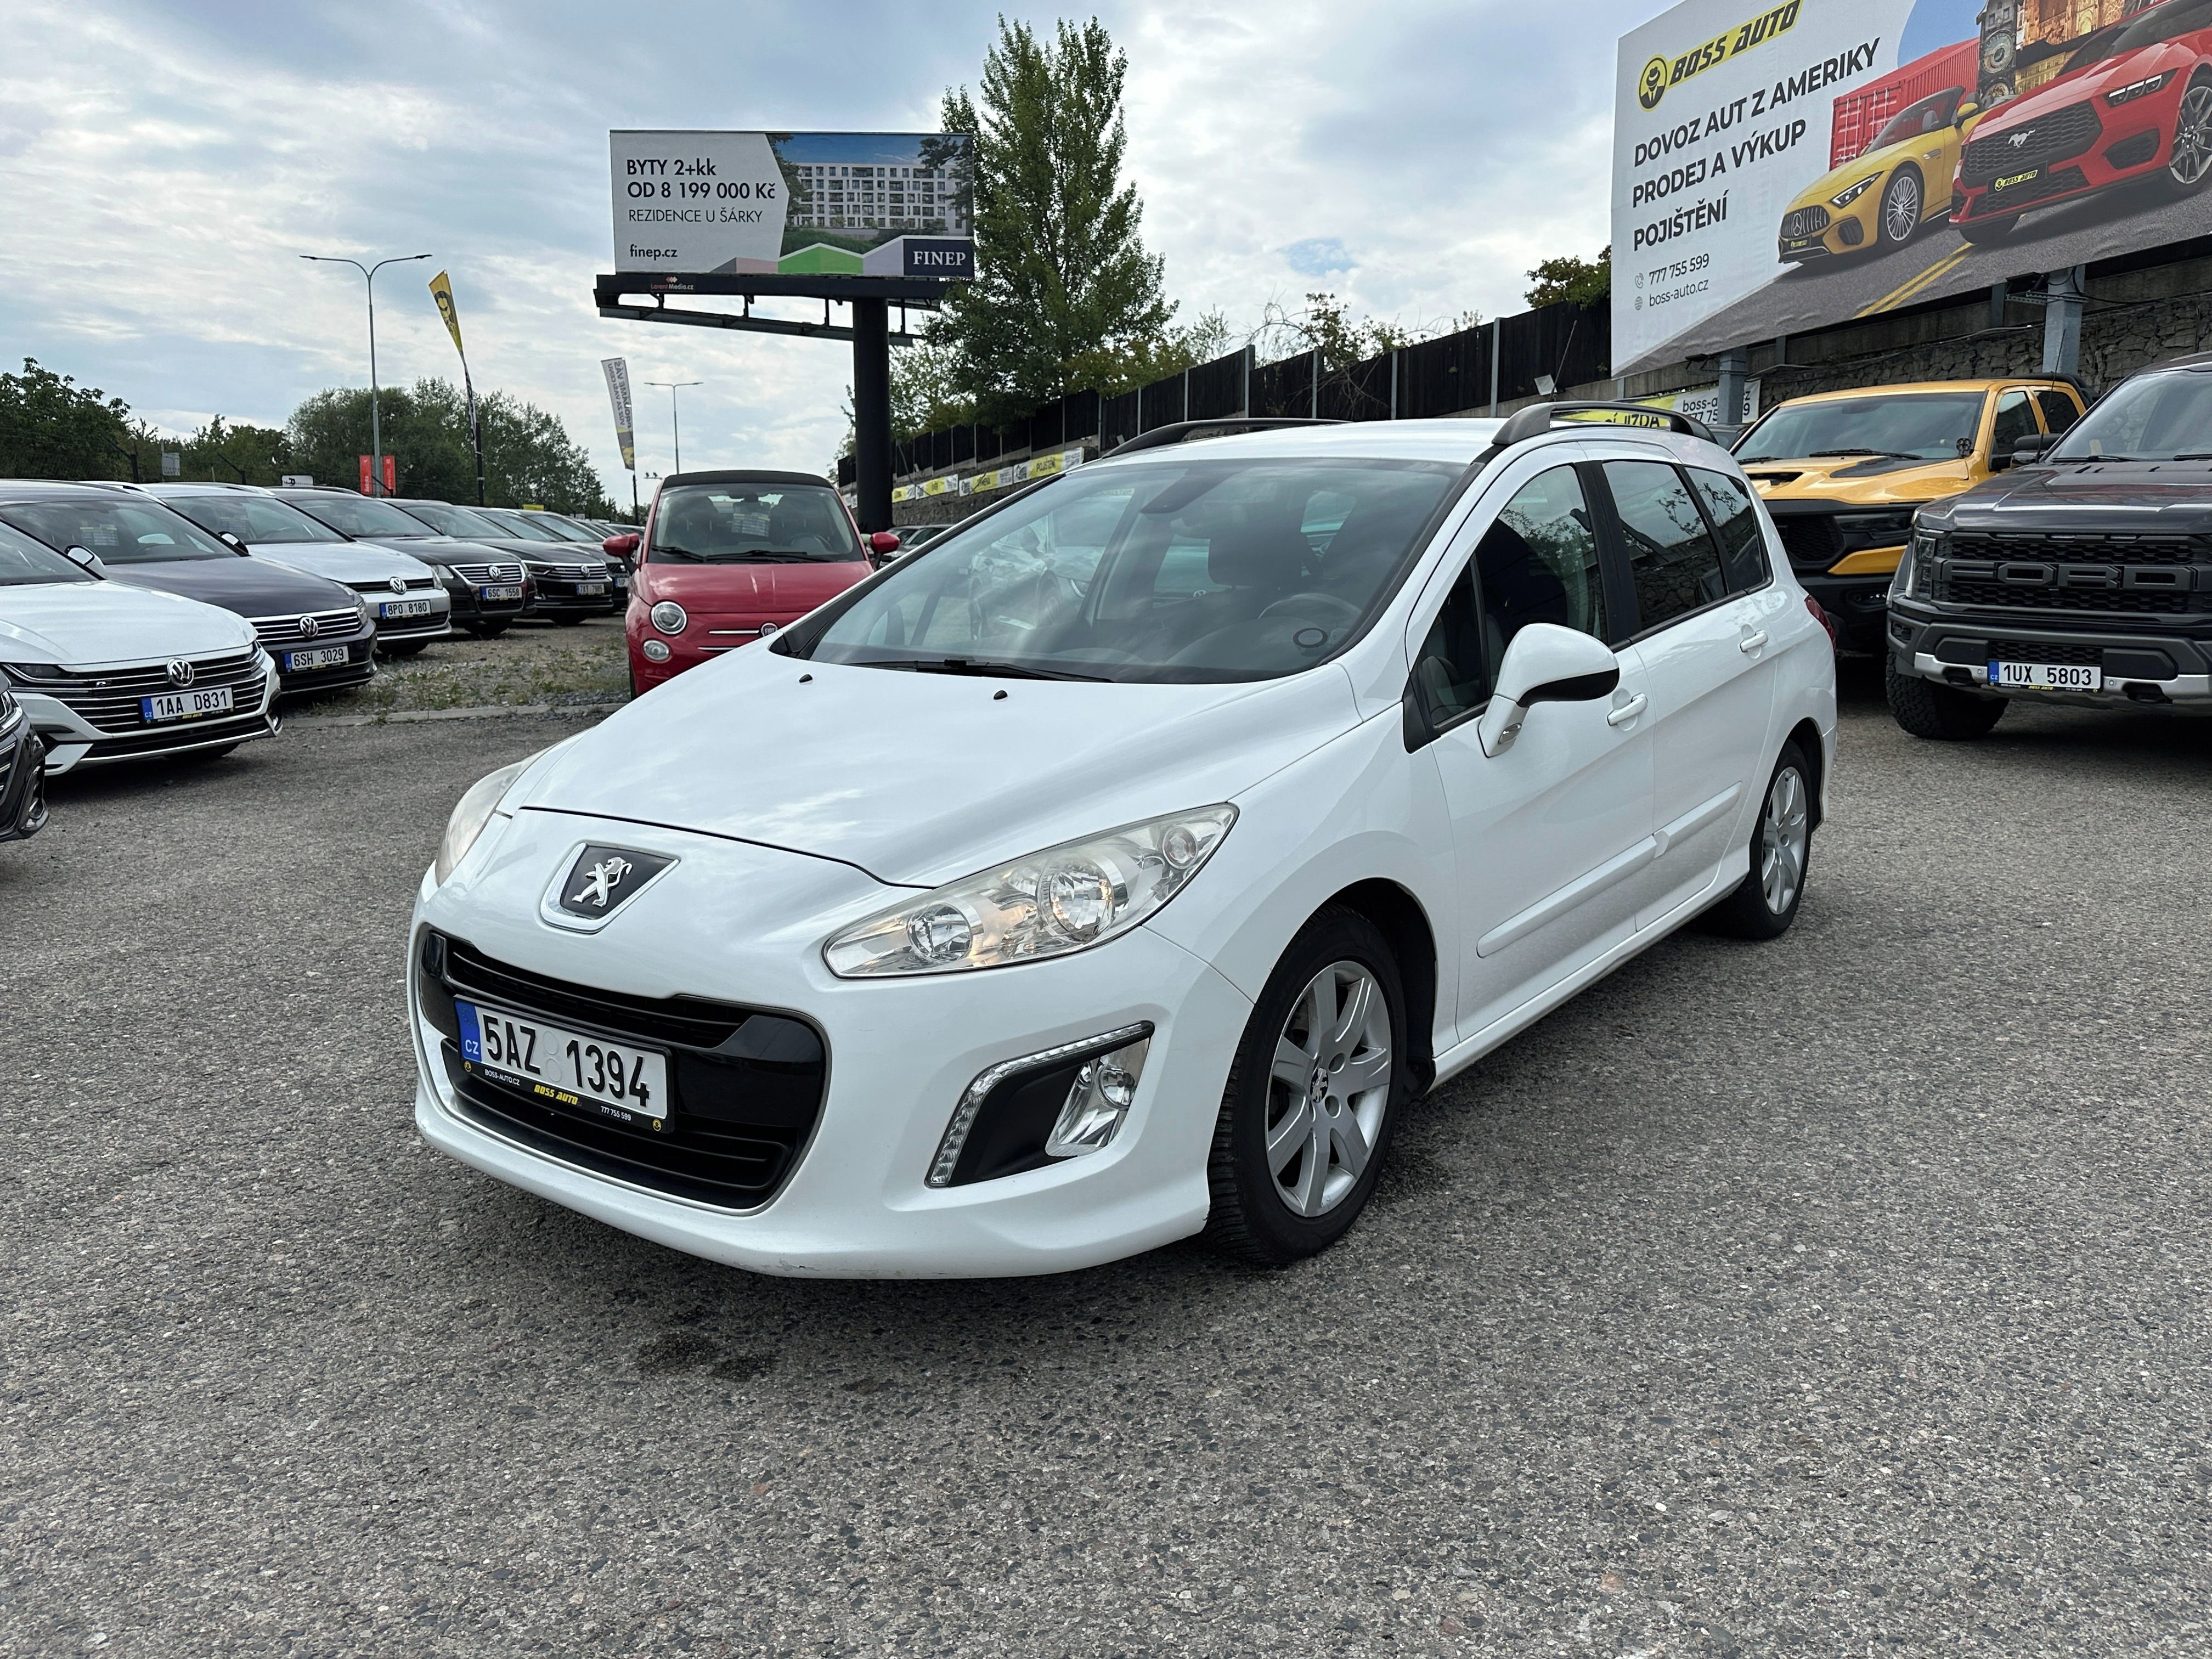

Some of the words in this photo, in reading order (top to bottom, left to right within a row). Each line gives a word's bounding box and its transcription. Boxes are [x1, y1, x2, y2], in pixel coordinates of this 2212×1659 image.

[1669, 35, 1728, 86] BOSS
[1730, 0, 1800, 55] AUTO
[1634, 117, 1701, 167] DOVOZ
[1704, 97, 1747, 138] AUT
[1751, 89, 1765, 117] Z
[1769, 37, 1880, 110] AMERIKY
[627, 159, 668, 175] BYTY
[674, 158, 716, 176] 2+kk
[1633, 158, 1706, 208] PRODEJ
[1711, 152, 1726, 178] A
[1731, 119, 1806, 168] VÝKUP
[627, 182, 655, 198] OD
[661, 182, 671, 198] 8
[680, 182, 710, 198] 199
[716, 183, 750, 199] 000
[756, 183, 775, 199] Kč
[629, 210, 701, 222] REZIDENCE
[706, 210, 715, 223] U
[720, 207, 763, 223] ŠÁRKY
[1634, 189, 1729, 251] POJIŠTĚNÍ
[630, 244, 678, 261] finep.cz
[913, 251, 966, 266] FINEP
[1649, 267, 1667, 285] 777
[1669, 260, 1687, 279] 755
[1689, 253, 1709, 272] 599
[1649, 279, 1709, 307] boss-auto.cz
[1942, 559, 2193, 591] FORD
[488, 588, 500, 597] 6SC
[409, 602, 427, 613] 8180
[294, 652, 313, 667] 6SH
[320, 648, 344, 663] 3029
[2004, 665, 2033, 683] 1UX
[2047, 667, 2091, 686] 5803
[157, 697, 184, 715] 1AA
[194, 691, 227, 711] D831
[465, 1040, 479, 1055] CZ
[483, 1014, 541, 1075] 5AZ
[567, 1040, 650, 1107] 1394
[485, 1069, 521, 1086] BOSS-AUTO.CZ
[534, 1085, 555, 1098] BOSS
[556, 1092, 578, 1105] AUTO
[620, 1111, 631, 1121] 599
